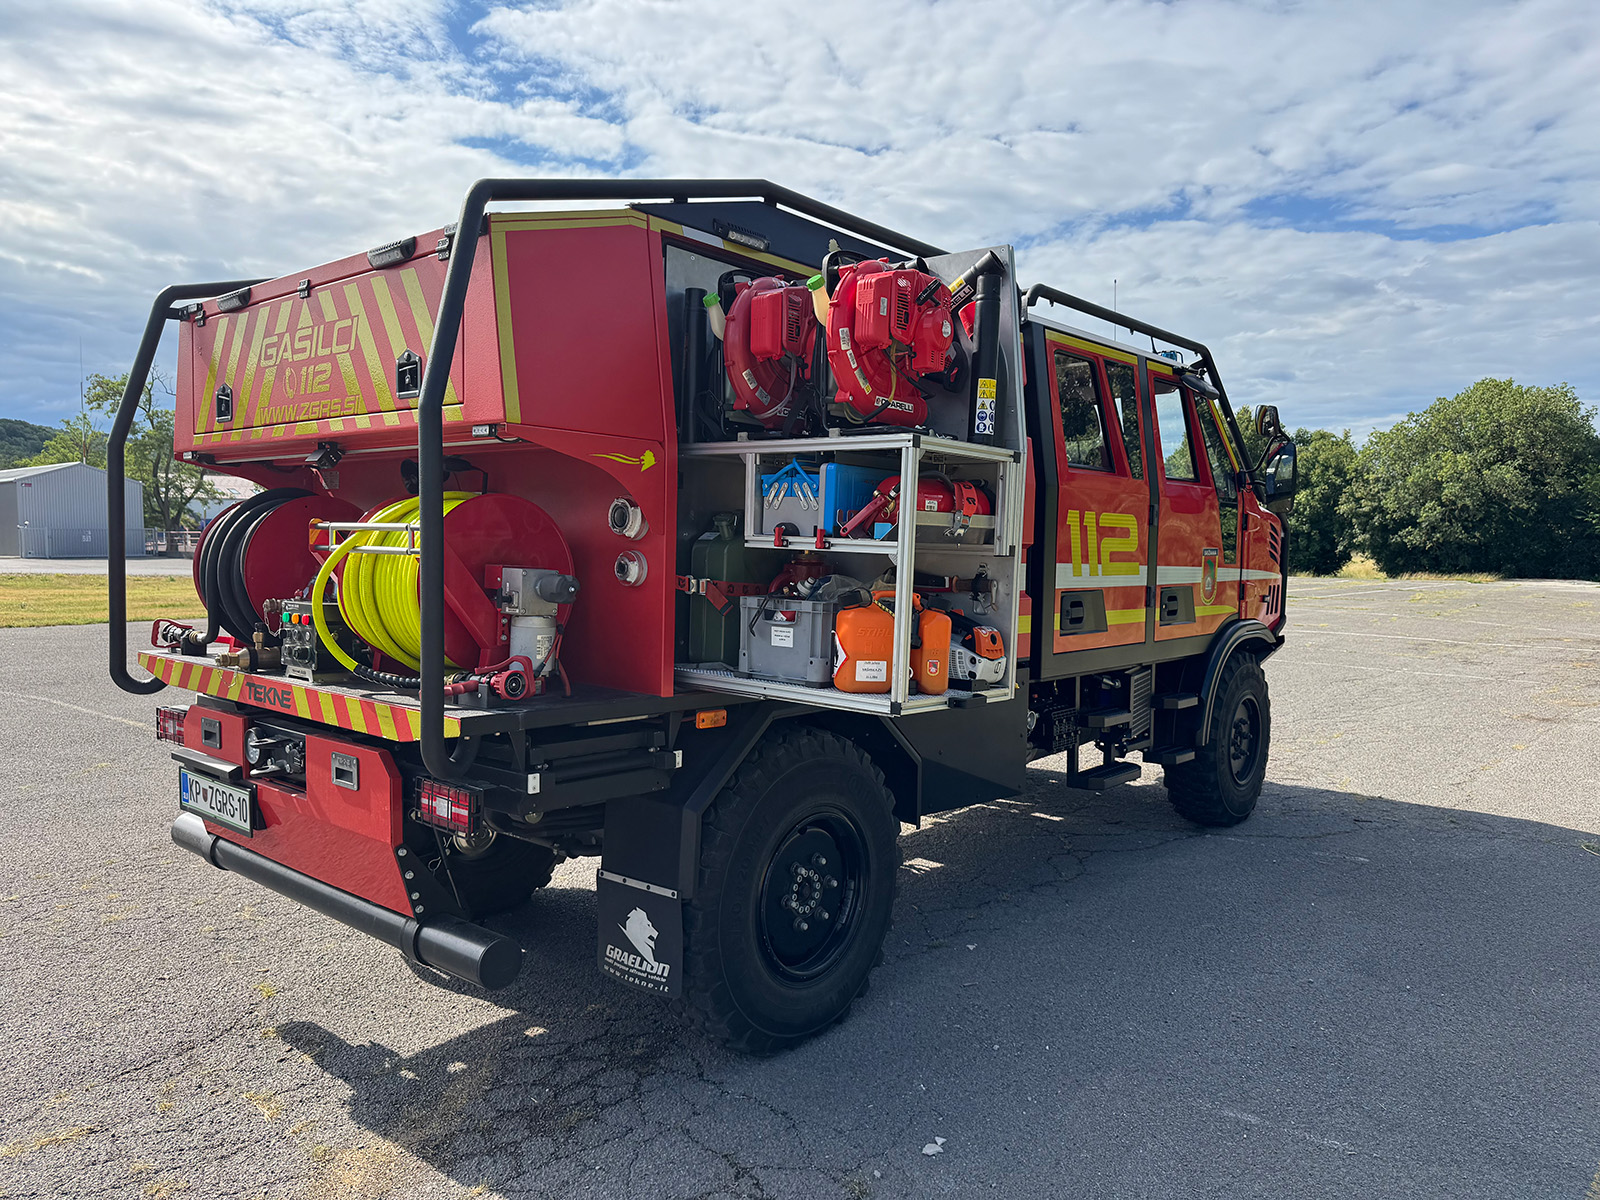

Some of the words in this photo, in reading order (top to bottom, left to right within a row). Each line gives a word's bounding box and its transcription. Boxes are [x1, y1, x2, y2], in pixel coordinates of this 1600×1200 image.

[260, 315, 359, 368] GASILCI
[299, 362, 332, 395] 112
[260, 396, 360, 424] WWW.ZGRS.SI
[881, 399, 914, 411] CARELLI
[1066, 510, 1140, 577] 112
[244, 681, 292, 710] TEKNE
[188, 778, 201, 803] KP
[208, 785, 248, 823] ZGRS-10
[605, 944, 670, 977] GRAELION
[604, 965, 670, 993] www.tekne.it
[648, 974, 666, 982] vehicle
